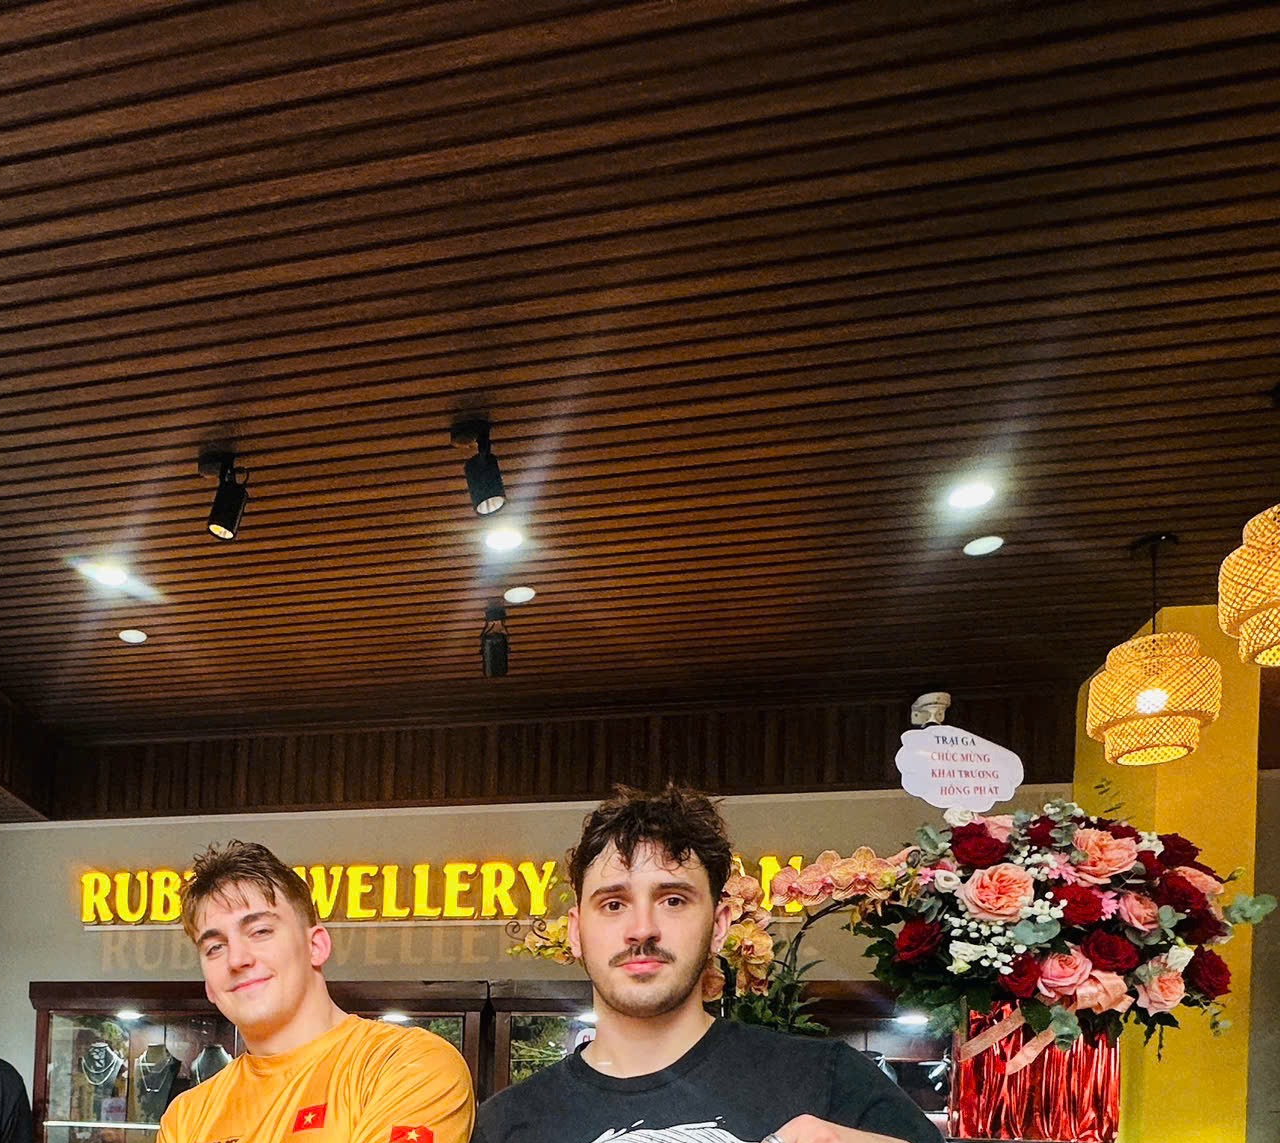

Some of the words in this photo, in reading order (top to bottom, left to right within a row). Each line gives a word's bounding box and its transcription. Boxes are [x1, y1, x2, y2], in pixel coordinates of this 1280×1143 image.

[931, 769, 955, 778] KHAI
[81, 871, 198, 923] RUB
[292, 861, 556, 919] WELLERY
